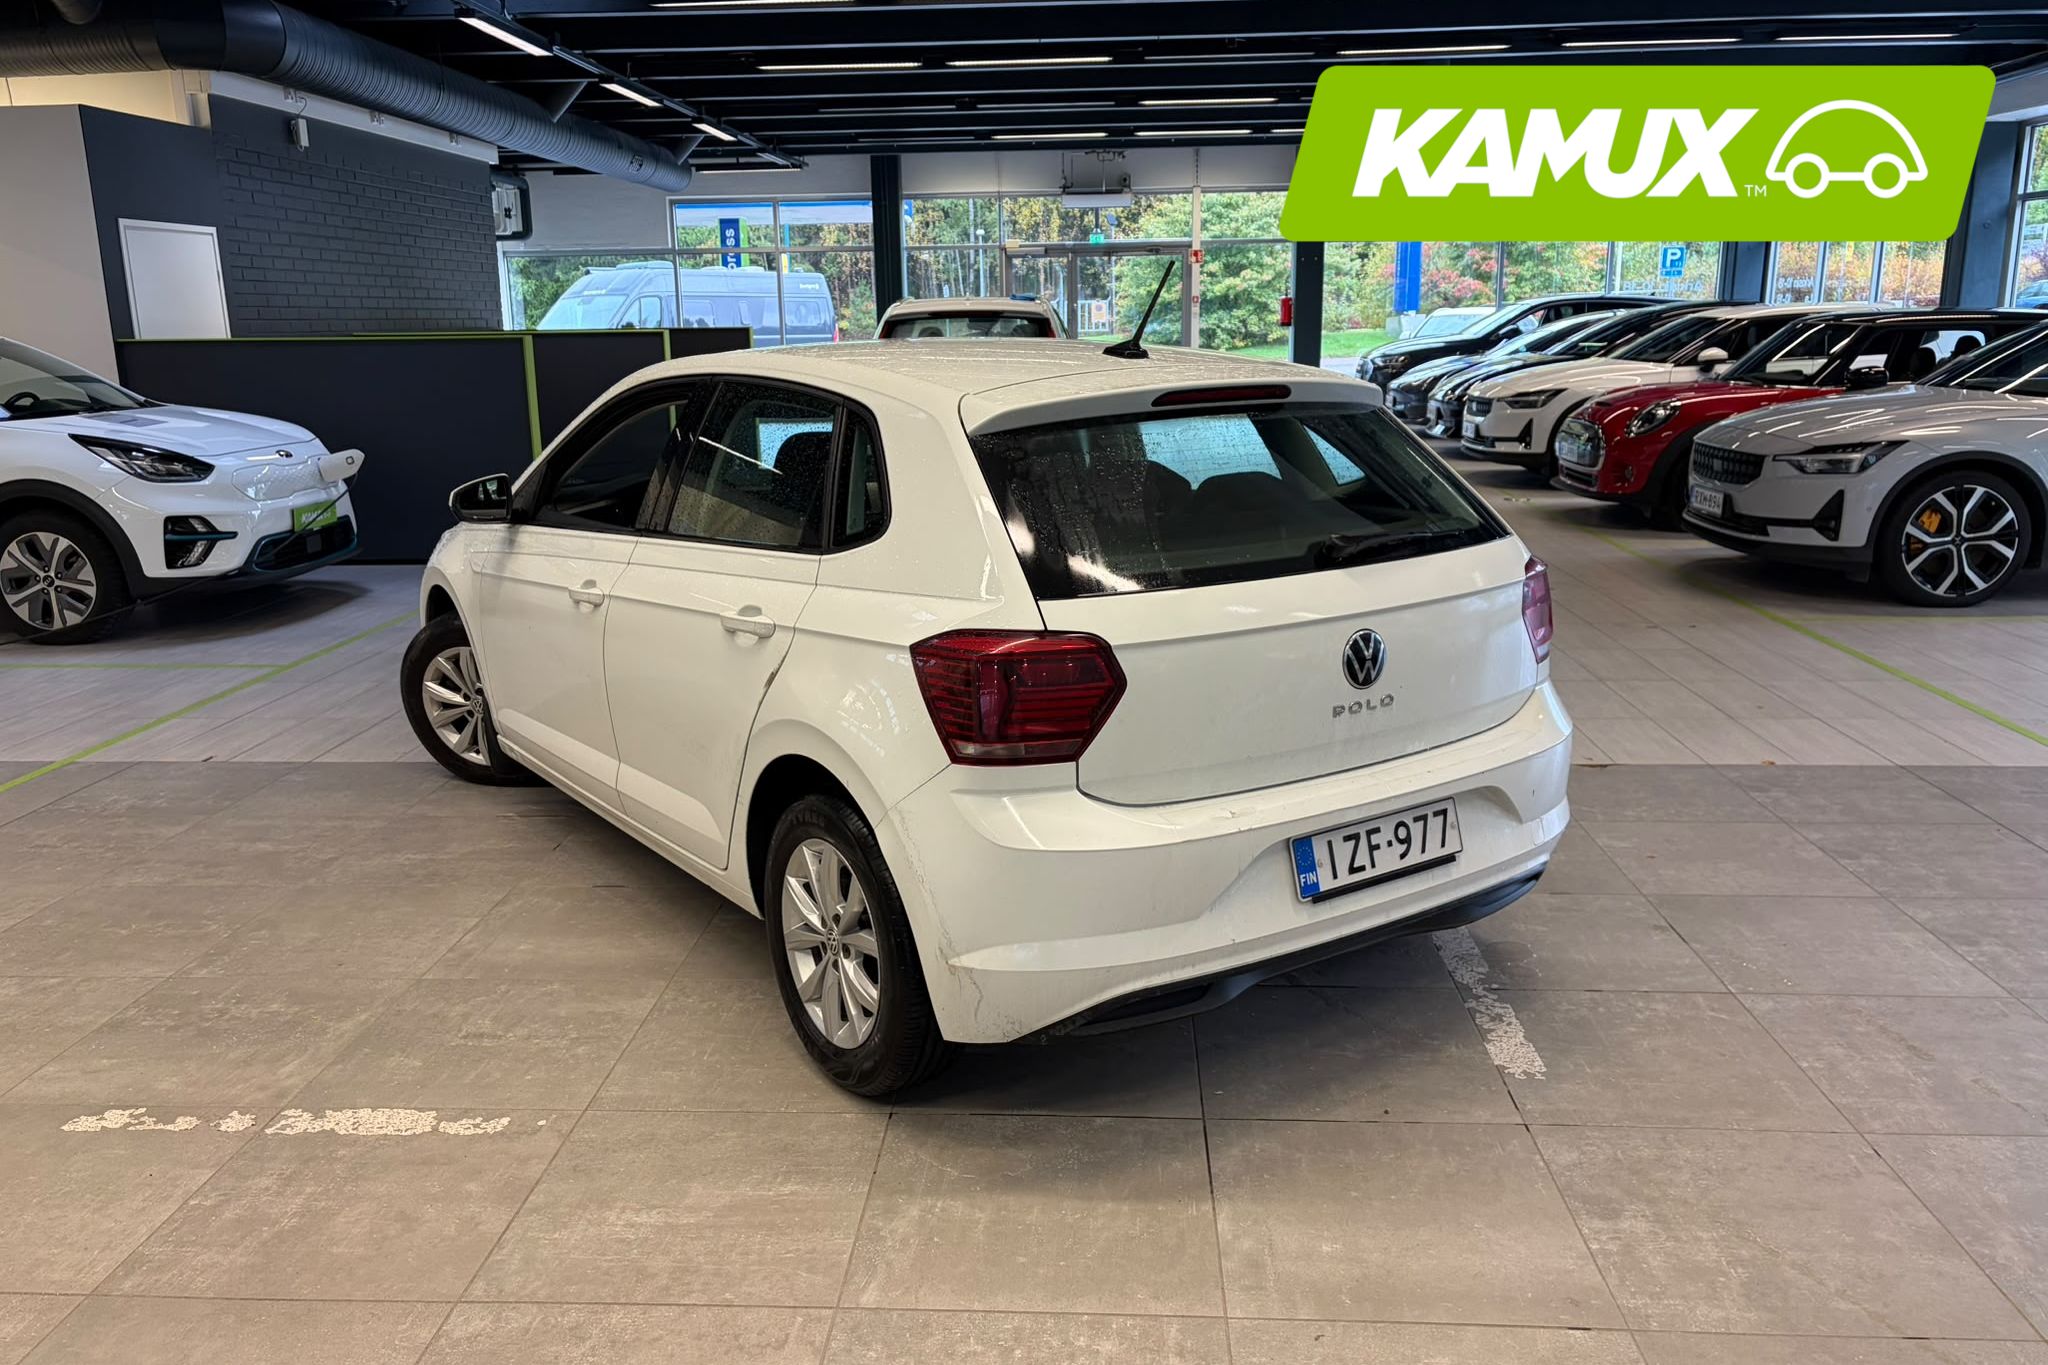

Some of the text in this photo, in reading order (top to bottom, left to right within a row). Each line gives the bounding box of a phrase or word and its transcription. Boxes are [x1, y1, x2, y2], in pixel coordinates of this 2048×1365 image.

[725, 228, 737, 272] prss
[1666, 248, 1682, 268] P
[1332, 693, 1395, 718] POLO
[1300, 871, 1317, 887] FIN
